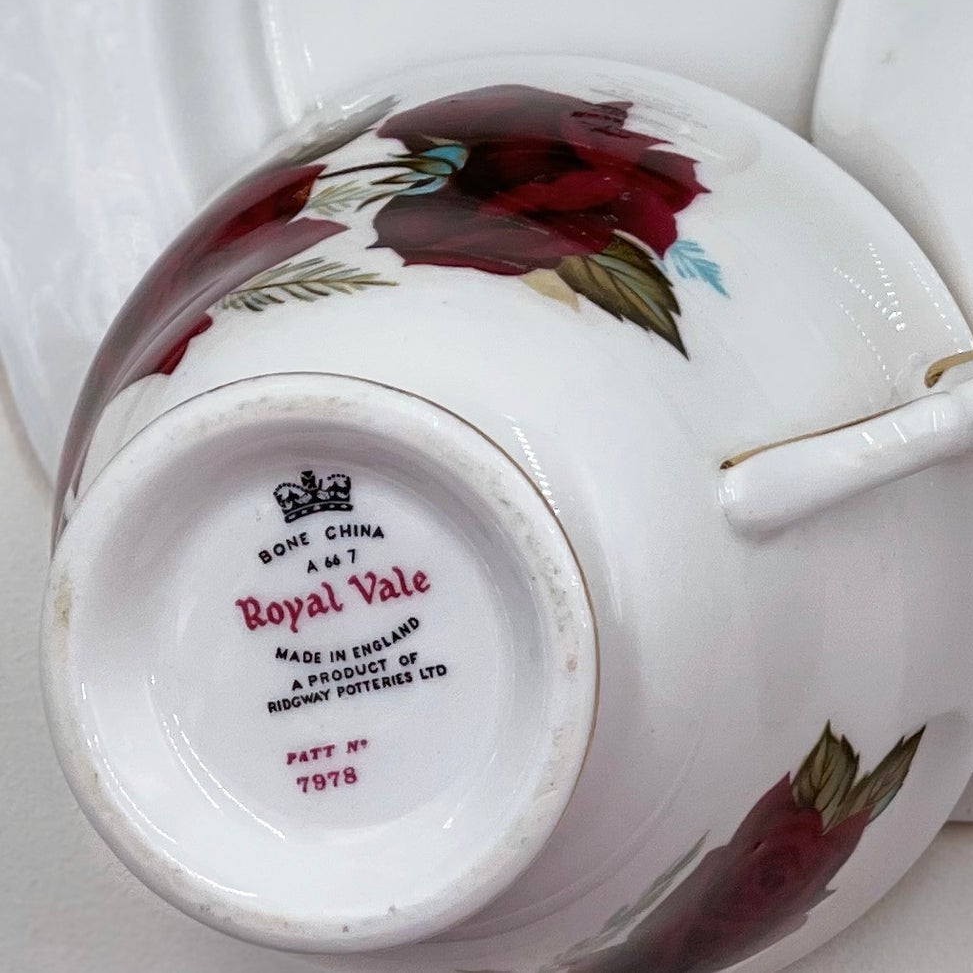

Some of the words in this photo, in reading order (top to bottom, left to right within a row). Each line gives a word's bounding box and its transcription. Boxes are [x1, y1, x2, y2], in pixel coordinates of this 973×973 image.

[258, 532, 310, 564] BONE
[325, 525, 384, 540] CHINA
[307, 560, 318, 573] A
[348, 549, 356, 564] 7
[235, 582, 343, 633] Royal
[348, 566, 431, 604] Vale
[276, 647, 321, 664] MADE
[330, 650, 346, 663] IN
[353, 617, 419, 659] ENGLAND
[268, 689, 330, 713] RIDGWAY
[337, 672, 412, 698] POTTERIES
[420, 664, 447, 679] LTD
[292, 679, 303, 691] A
[309, 659, 387, 687] PRODUCT
[399, 653, 418, 666] OF
[286, 744, 335, 765] PATT
[297, 767, 357, 793] 7978
